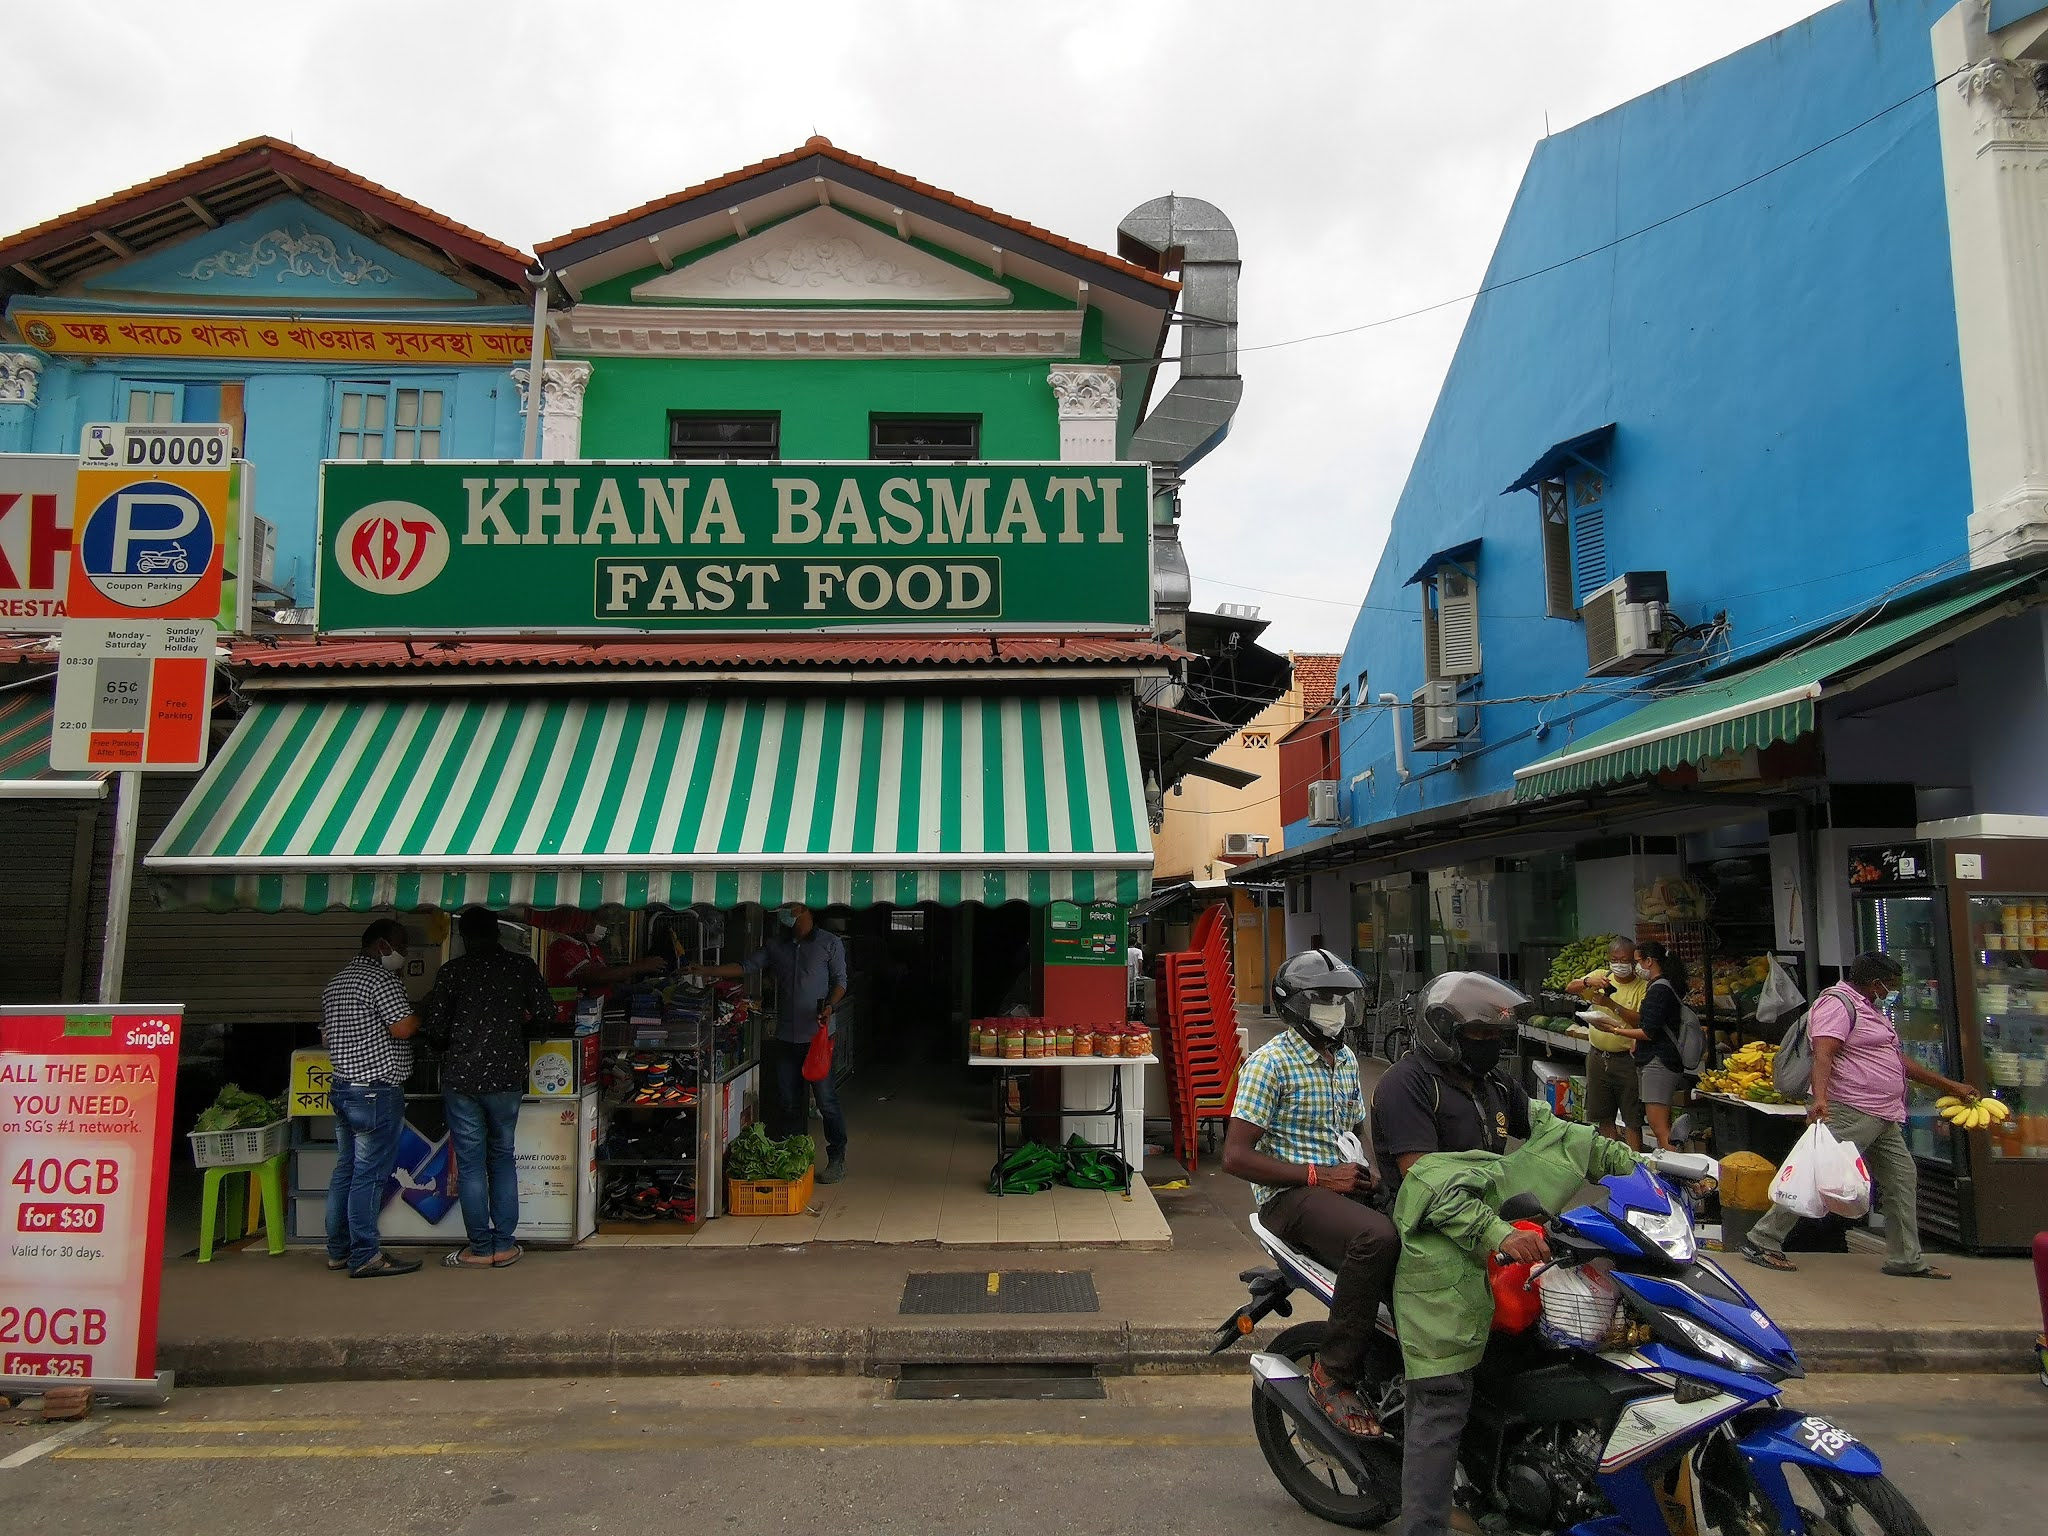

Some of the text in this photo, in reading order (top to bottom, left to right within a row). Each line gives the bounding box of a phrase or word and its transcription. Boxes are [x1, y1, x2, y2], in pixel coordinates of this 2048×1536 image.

[61, 323, 111, 345] অল্প
[118, 323, 182, 346] খরচে
[191, 324, 249, 348] থাকা
[258, 329, 280, 347] ও
[287, 327, 376, 351] খাওয়ার
[381, 331, 474, 358] সুব্যবস্থা
[127, 437, 223, 465] D0009
[82, 460, 119, 468] Parking.sg
[462, 475, 1124, 545] KHANA BASMATI
[111, 493, 200, 573] P
[351, 516, 437, 581] KBT
[106, 581, 183, 592] Coupon Parking
[606, 563, 992, 611] FAST FOOD
[166, 627, 205, 636] Sunday/
[168, 635, 197, 643] Public
[105, 640, 147, 650] Saturday
[164, 644, 199, 653] Holiday
[66, 657, 94, 666] 08:30
[106, 681, 138, 694] 65¢
[103, 696, 139, 706] Per Day
[166, 700, 187, 708] Free
[158, 712, 193, 721] Parking
[60, 722, 87, 730] 22:00
[112, 739, 140, 748] Parking
[126, 1030, 175, 1049] Singtel
[0, 1064, 158, 1085] ALL THE DATA
[13, 1095, 136, 1119] YOU NEED,
[3, 1120, 142, 1133] on SG's #1 network.
[11, 1157, 120, 1195] 40GB
[25, 1206, 97, 1229] for $30
[11, 1244, 105, 1261] Valid for 30 days.
[0, 1306, 107, 1346] 20GB
[10, 1356, 84, 1377] for $25
